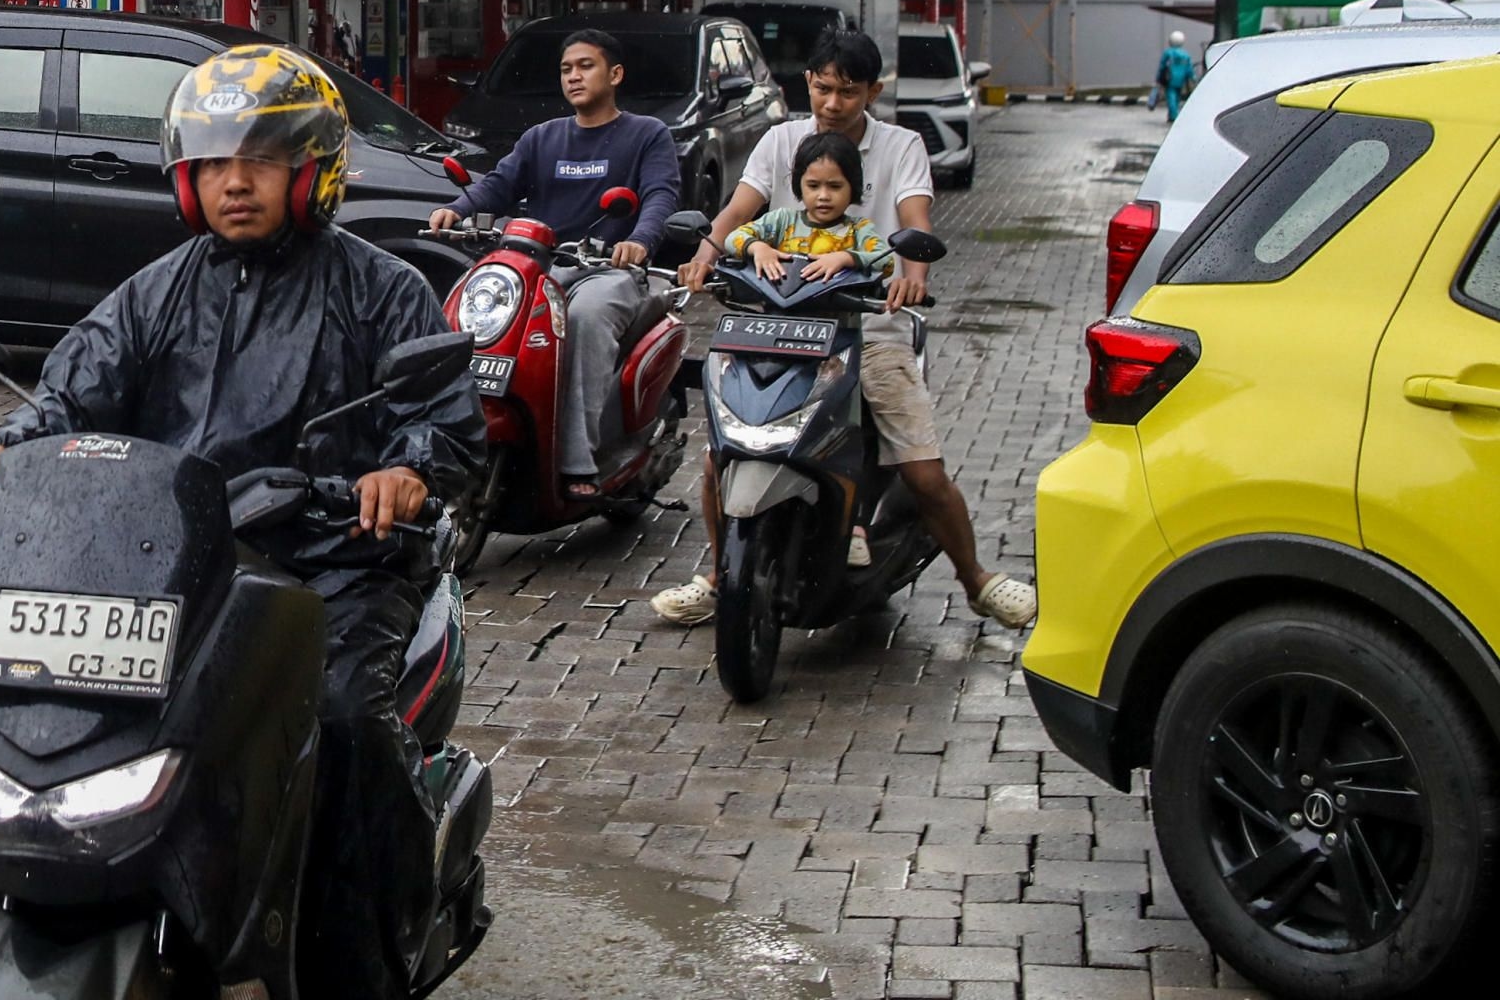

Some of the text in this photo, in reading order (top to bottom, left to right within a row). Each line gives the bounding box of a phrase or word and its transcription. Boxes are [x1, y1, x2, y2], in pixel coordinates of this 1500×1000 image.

[723, 320, 827, 339] B 4527 KVA
[478, 360, 507, 376] BIU
[9, 600, 91, 638] 5313
[105, 606, 168, 642] BAG
[53, 678, 161, 694] SEMAKIN DI DEPAN
